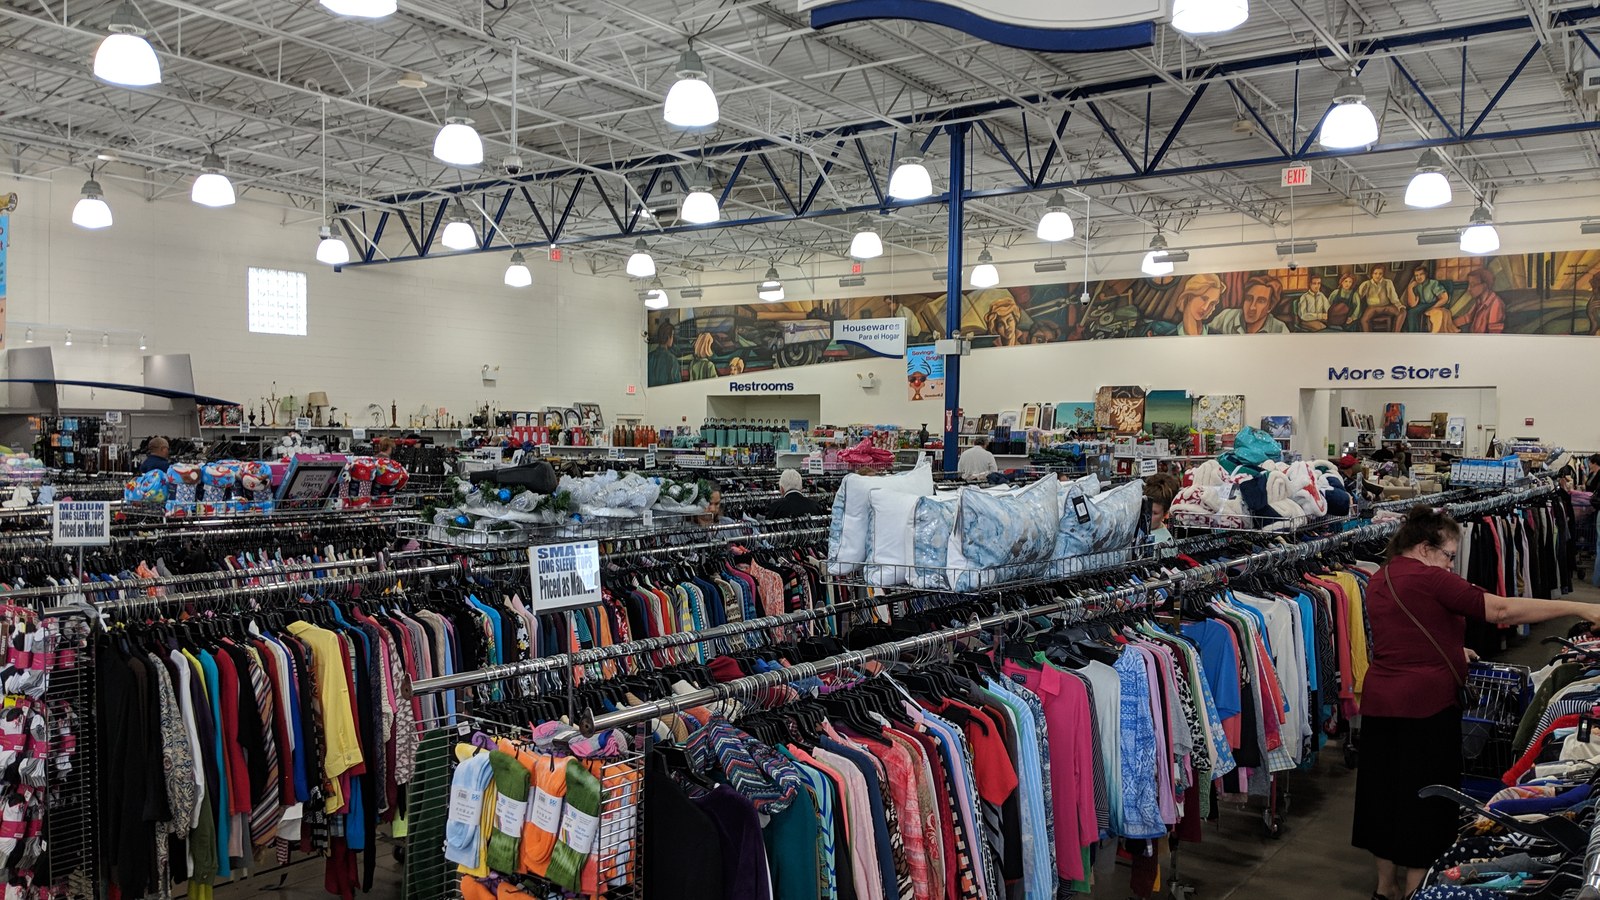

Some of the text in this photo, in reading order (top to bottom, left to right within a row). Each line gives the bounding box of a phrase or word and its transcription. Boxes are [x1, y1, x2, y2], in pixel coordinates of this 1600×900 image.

[1287, 168, 1306, 184] EXIT
[842, 323, 900, 332] Housewares
[881, 333, 900, 341] Hogar
[1328, 363, 1460, 380] More Store!
[729, 381, 794, 392] Restrooms
[59, 511, 104, 520] LONG SLEEVE TOPS
[59, 521, 104, 537] Priced as Marked
[538, 544, 592, 559] SMALL
[538, 559, 555, 574] LONG
[556, 557, 576, 572] SLEEVE
[539, 574, 562, 600] Priced
[562, 577, 570, 596] as
